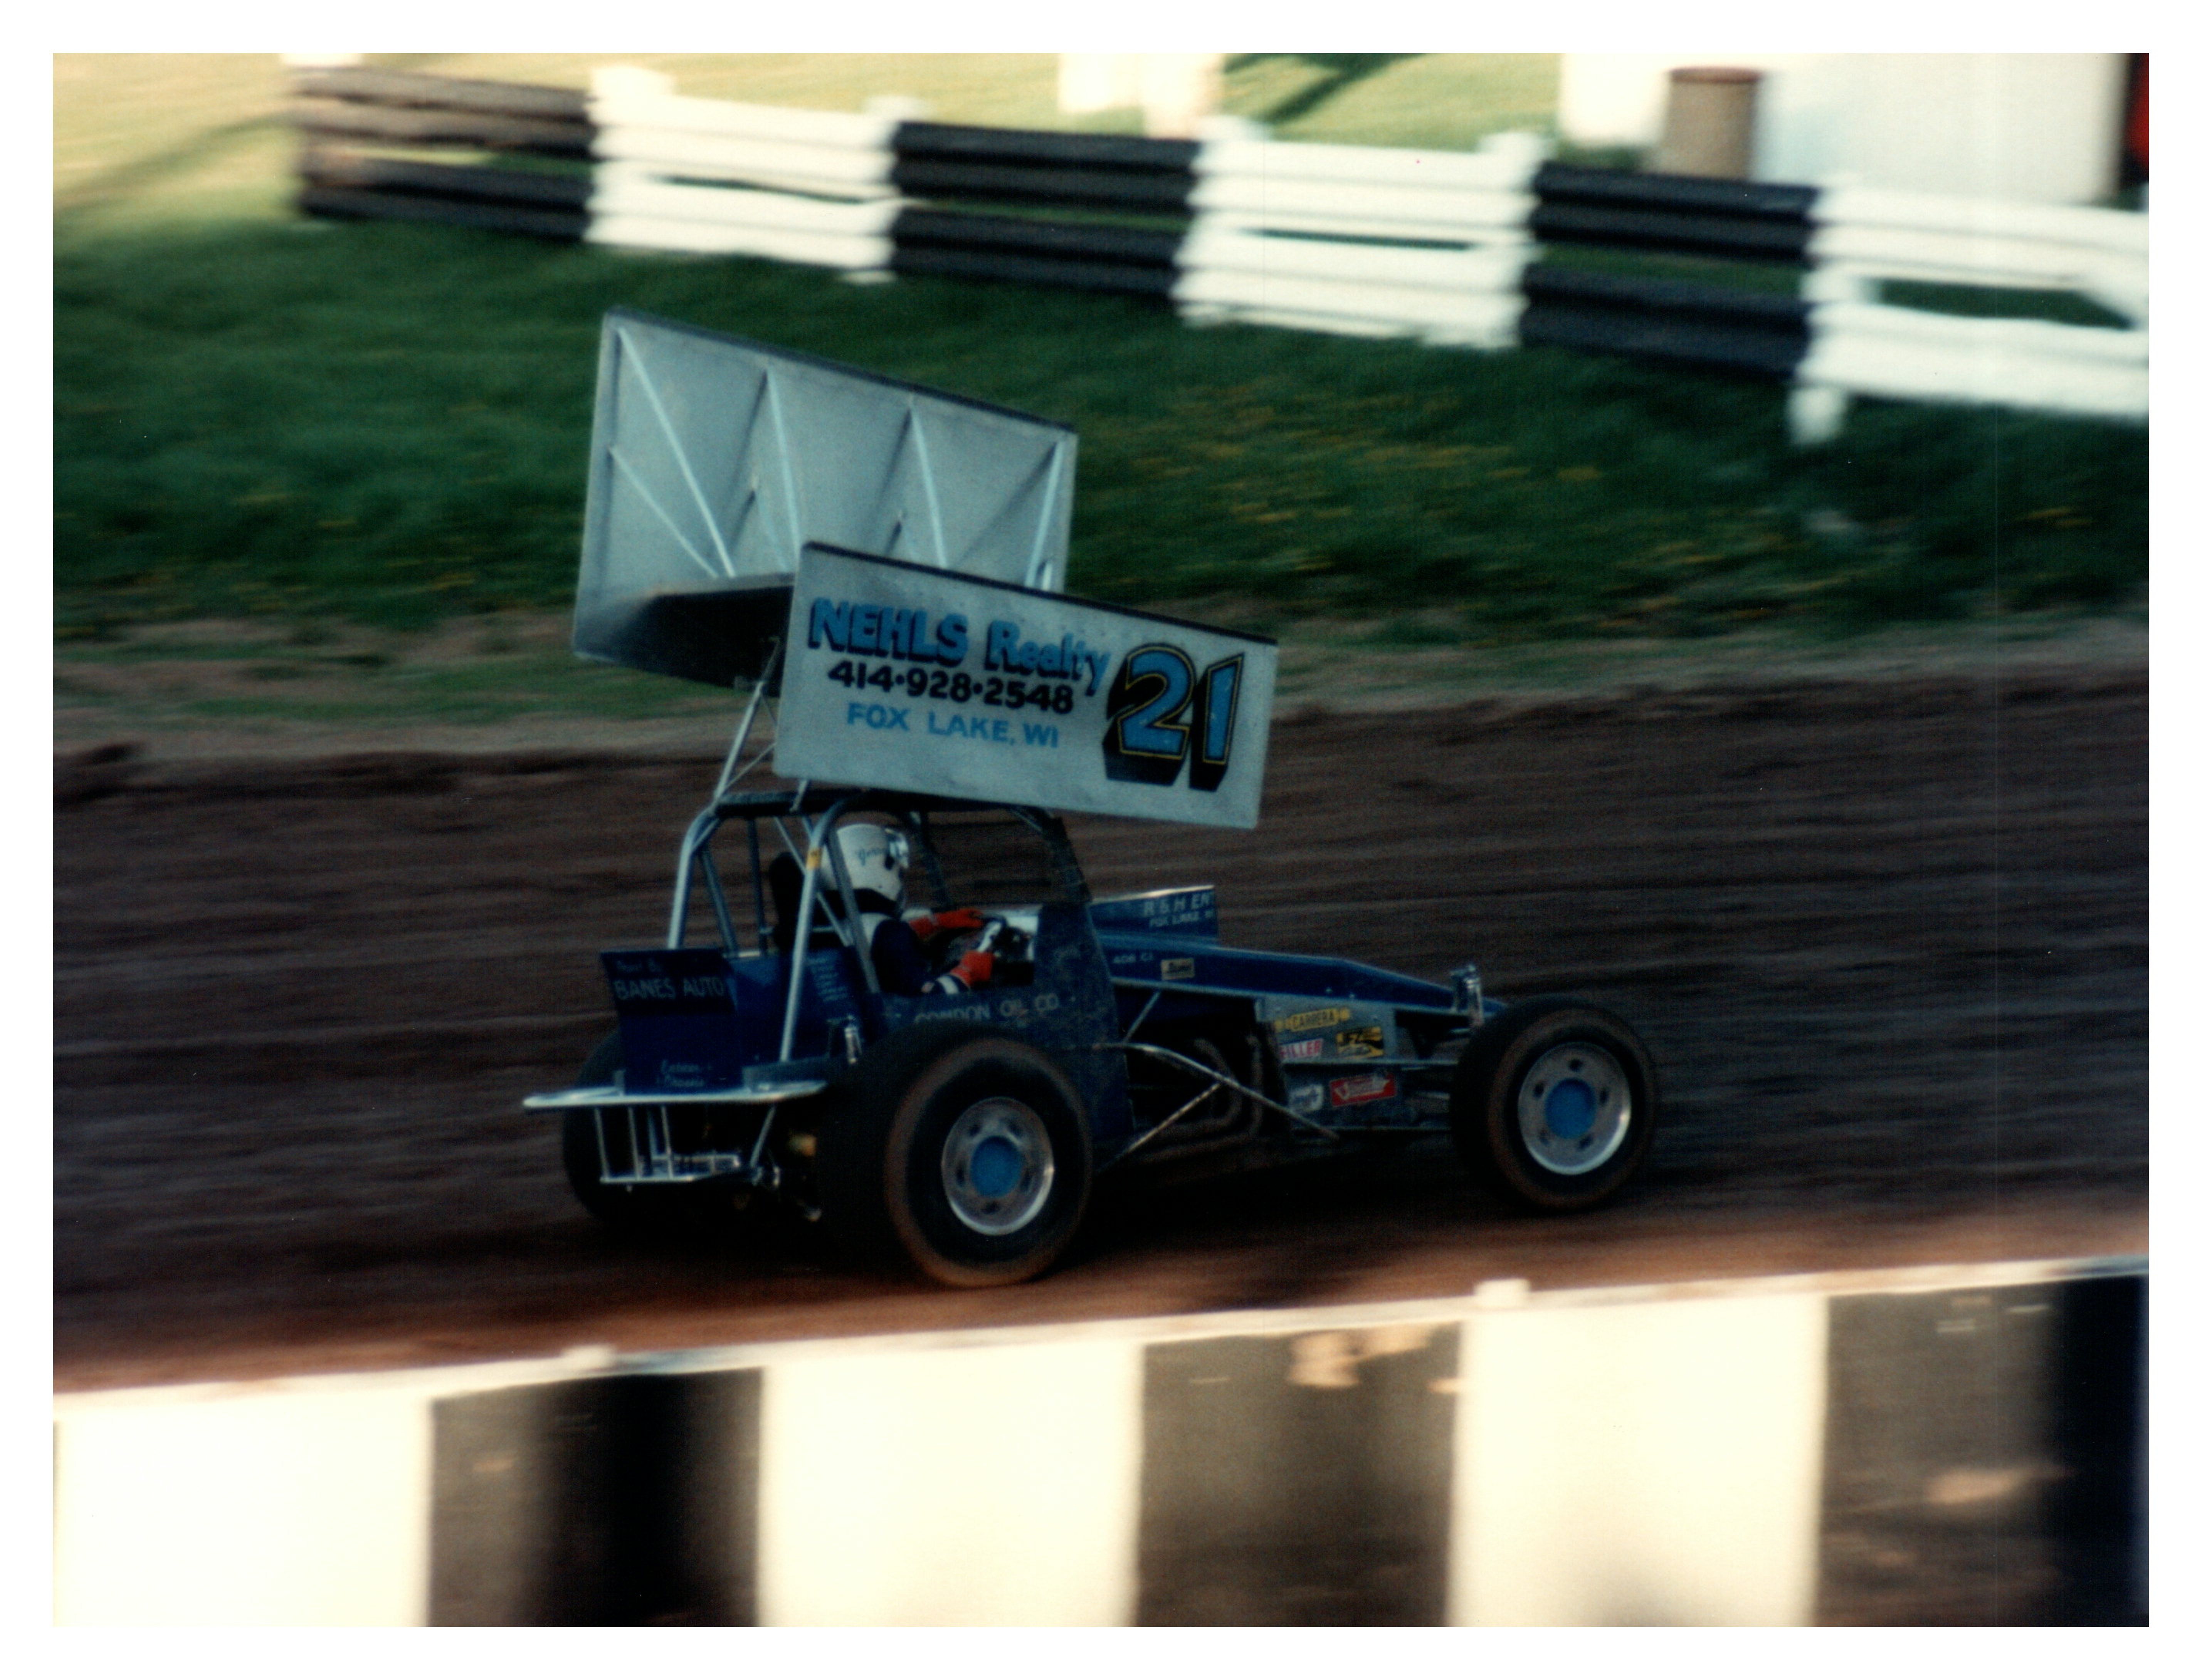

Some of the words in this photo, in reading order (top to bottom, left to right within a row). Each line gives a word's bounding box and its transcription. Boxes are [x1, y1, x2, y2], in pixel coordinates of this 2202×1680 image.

[808, 598, 968, 668] NEHLS
[983, 619, 1111, 697] Realty
[848, 702, 909, 731] FOX
[928, 713, 1015, 746] LAKE,
[1023, 724, 1059, 748] WI
[1102, 642, 1246, 792] 21
[682, 976, 726, 999] AUTO
